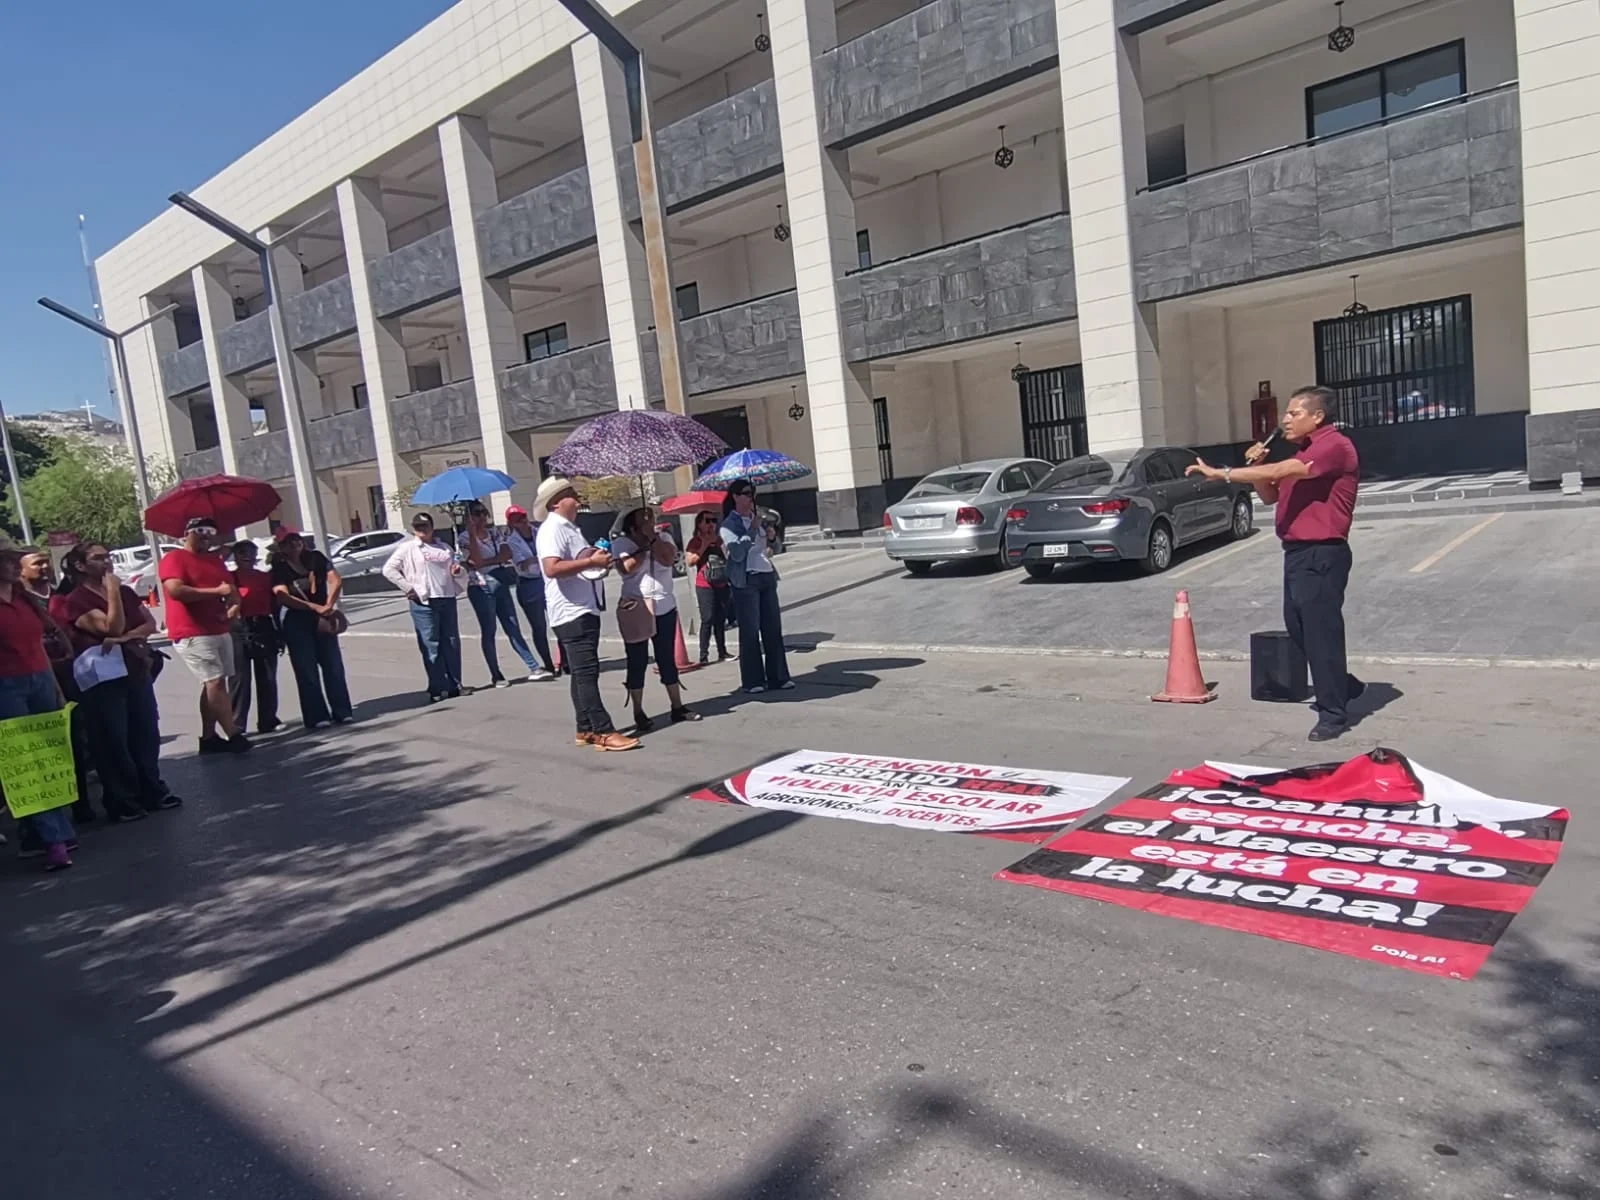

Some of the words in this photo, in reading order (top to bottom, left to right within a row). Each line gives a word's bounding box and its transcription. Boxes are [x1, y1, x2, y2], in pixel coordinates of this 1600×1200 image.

[803, 763, 958, 787] RESPALDO
[959, 778, 1048, 796] REAL
[826, 757, 992, 778] ATENCIÓN
[881, 781, 923, 791] ANTE
[751, 792, 854, 811] AGRESIONES
[768, 775, 901, 798] VIOLENCIA
[903, 791, 1043, 814] ESCOLAR
[1103, 819, 1172, 837] el
[1174, 824, 1507, 879] Maestro
[1170, 806, 1472, 853] escucha,
[1130, 845, 1289, 877] está
[1308, 867, 1419, 895] en
[1070, 856, 1144, 883] la
[1156, 868, 1445, 927] lucha!
